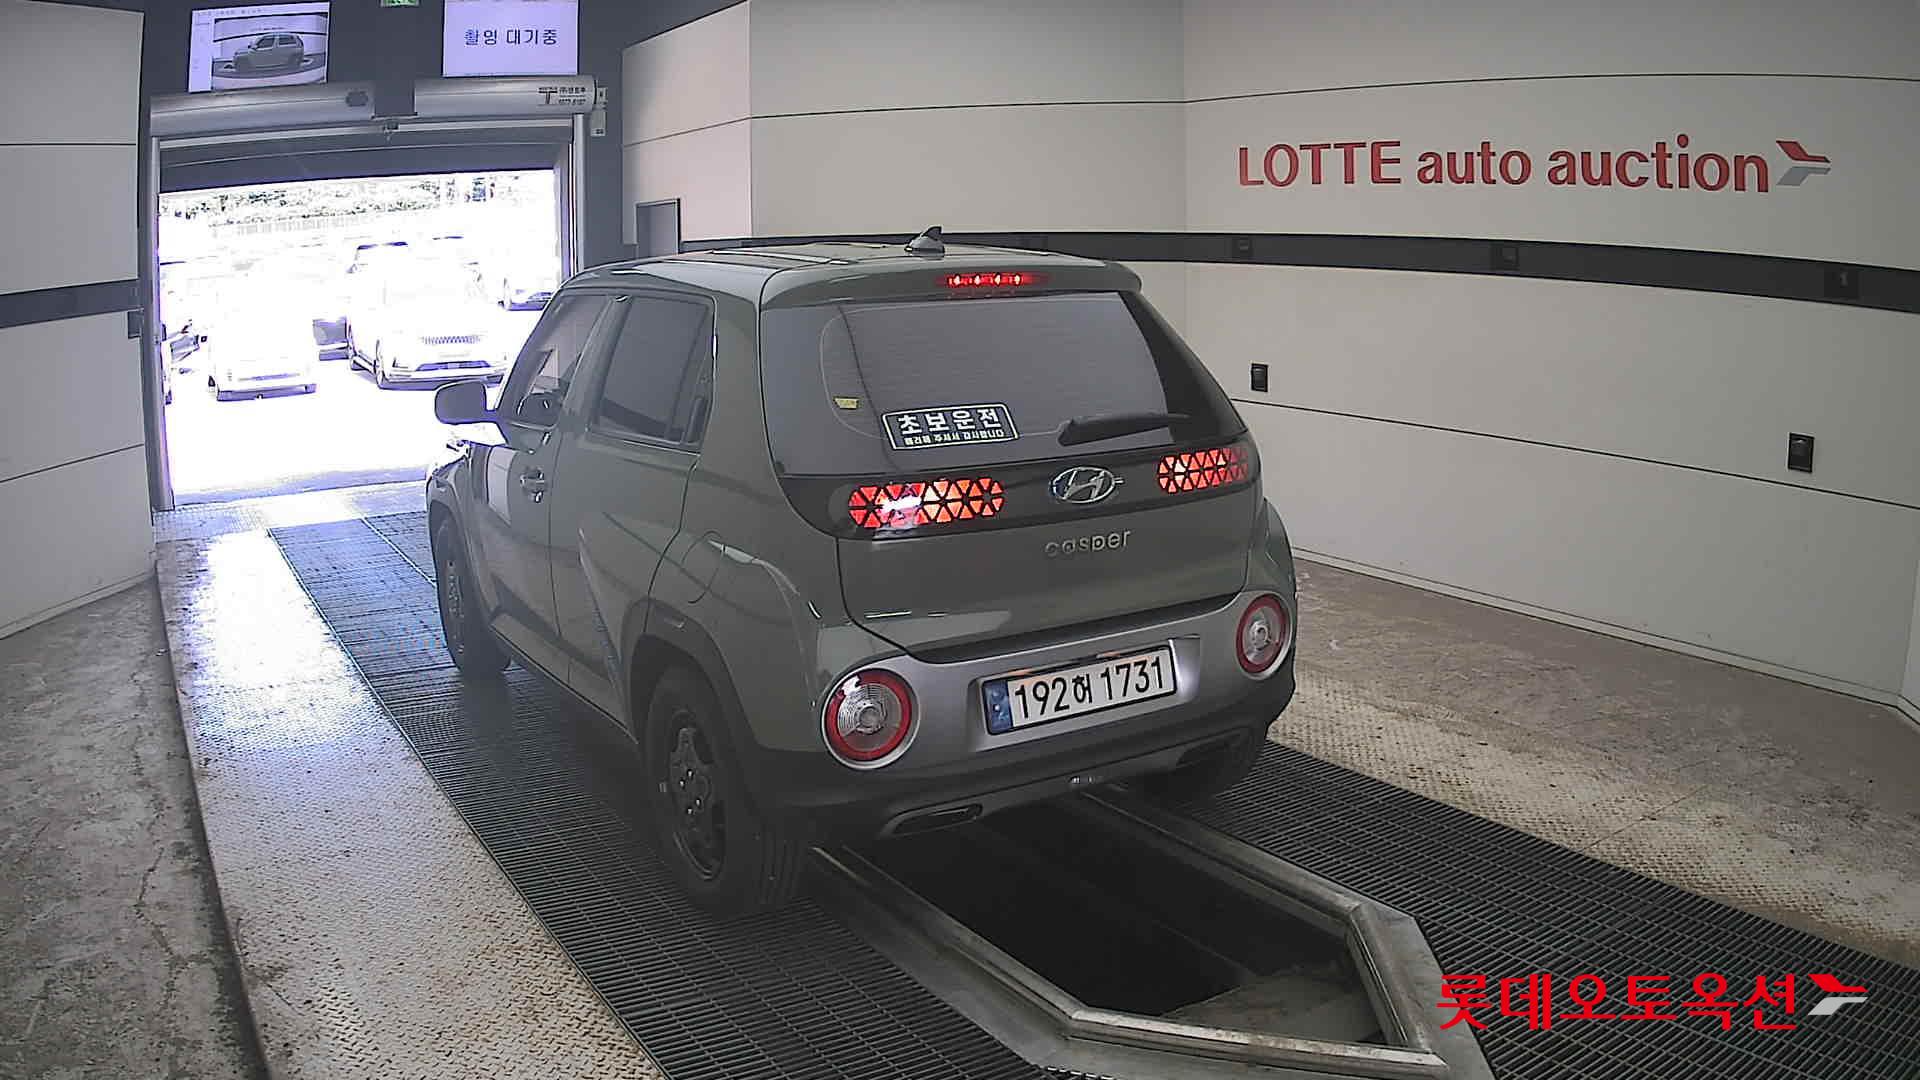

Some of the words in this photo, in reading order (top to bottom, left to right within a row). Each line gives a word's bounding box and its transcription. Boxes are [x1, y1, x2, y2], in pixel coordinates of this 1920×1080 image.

[506, 28, 558, 46] 대기중
[1239, 140, 1401, 187] LOTTE
[1416, 141, 1532, 185] auto
[1547, 134, 1769, 193] auction
[898, 408, 1002, 435] 초보운전
[1044, 529, 1132, 557] casper
[1014, 673, 1093, 719] 192허
[1100, 656, 1164, 701] 1731
